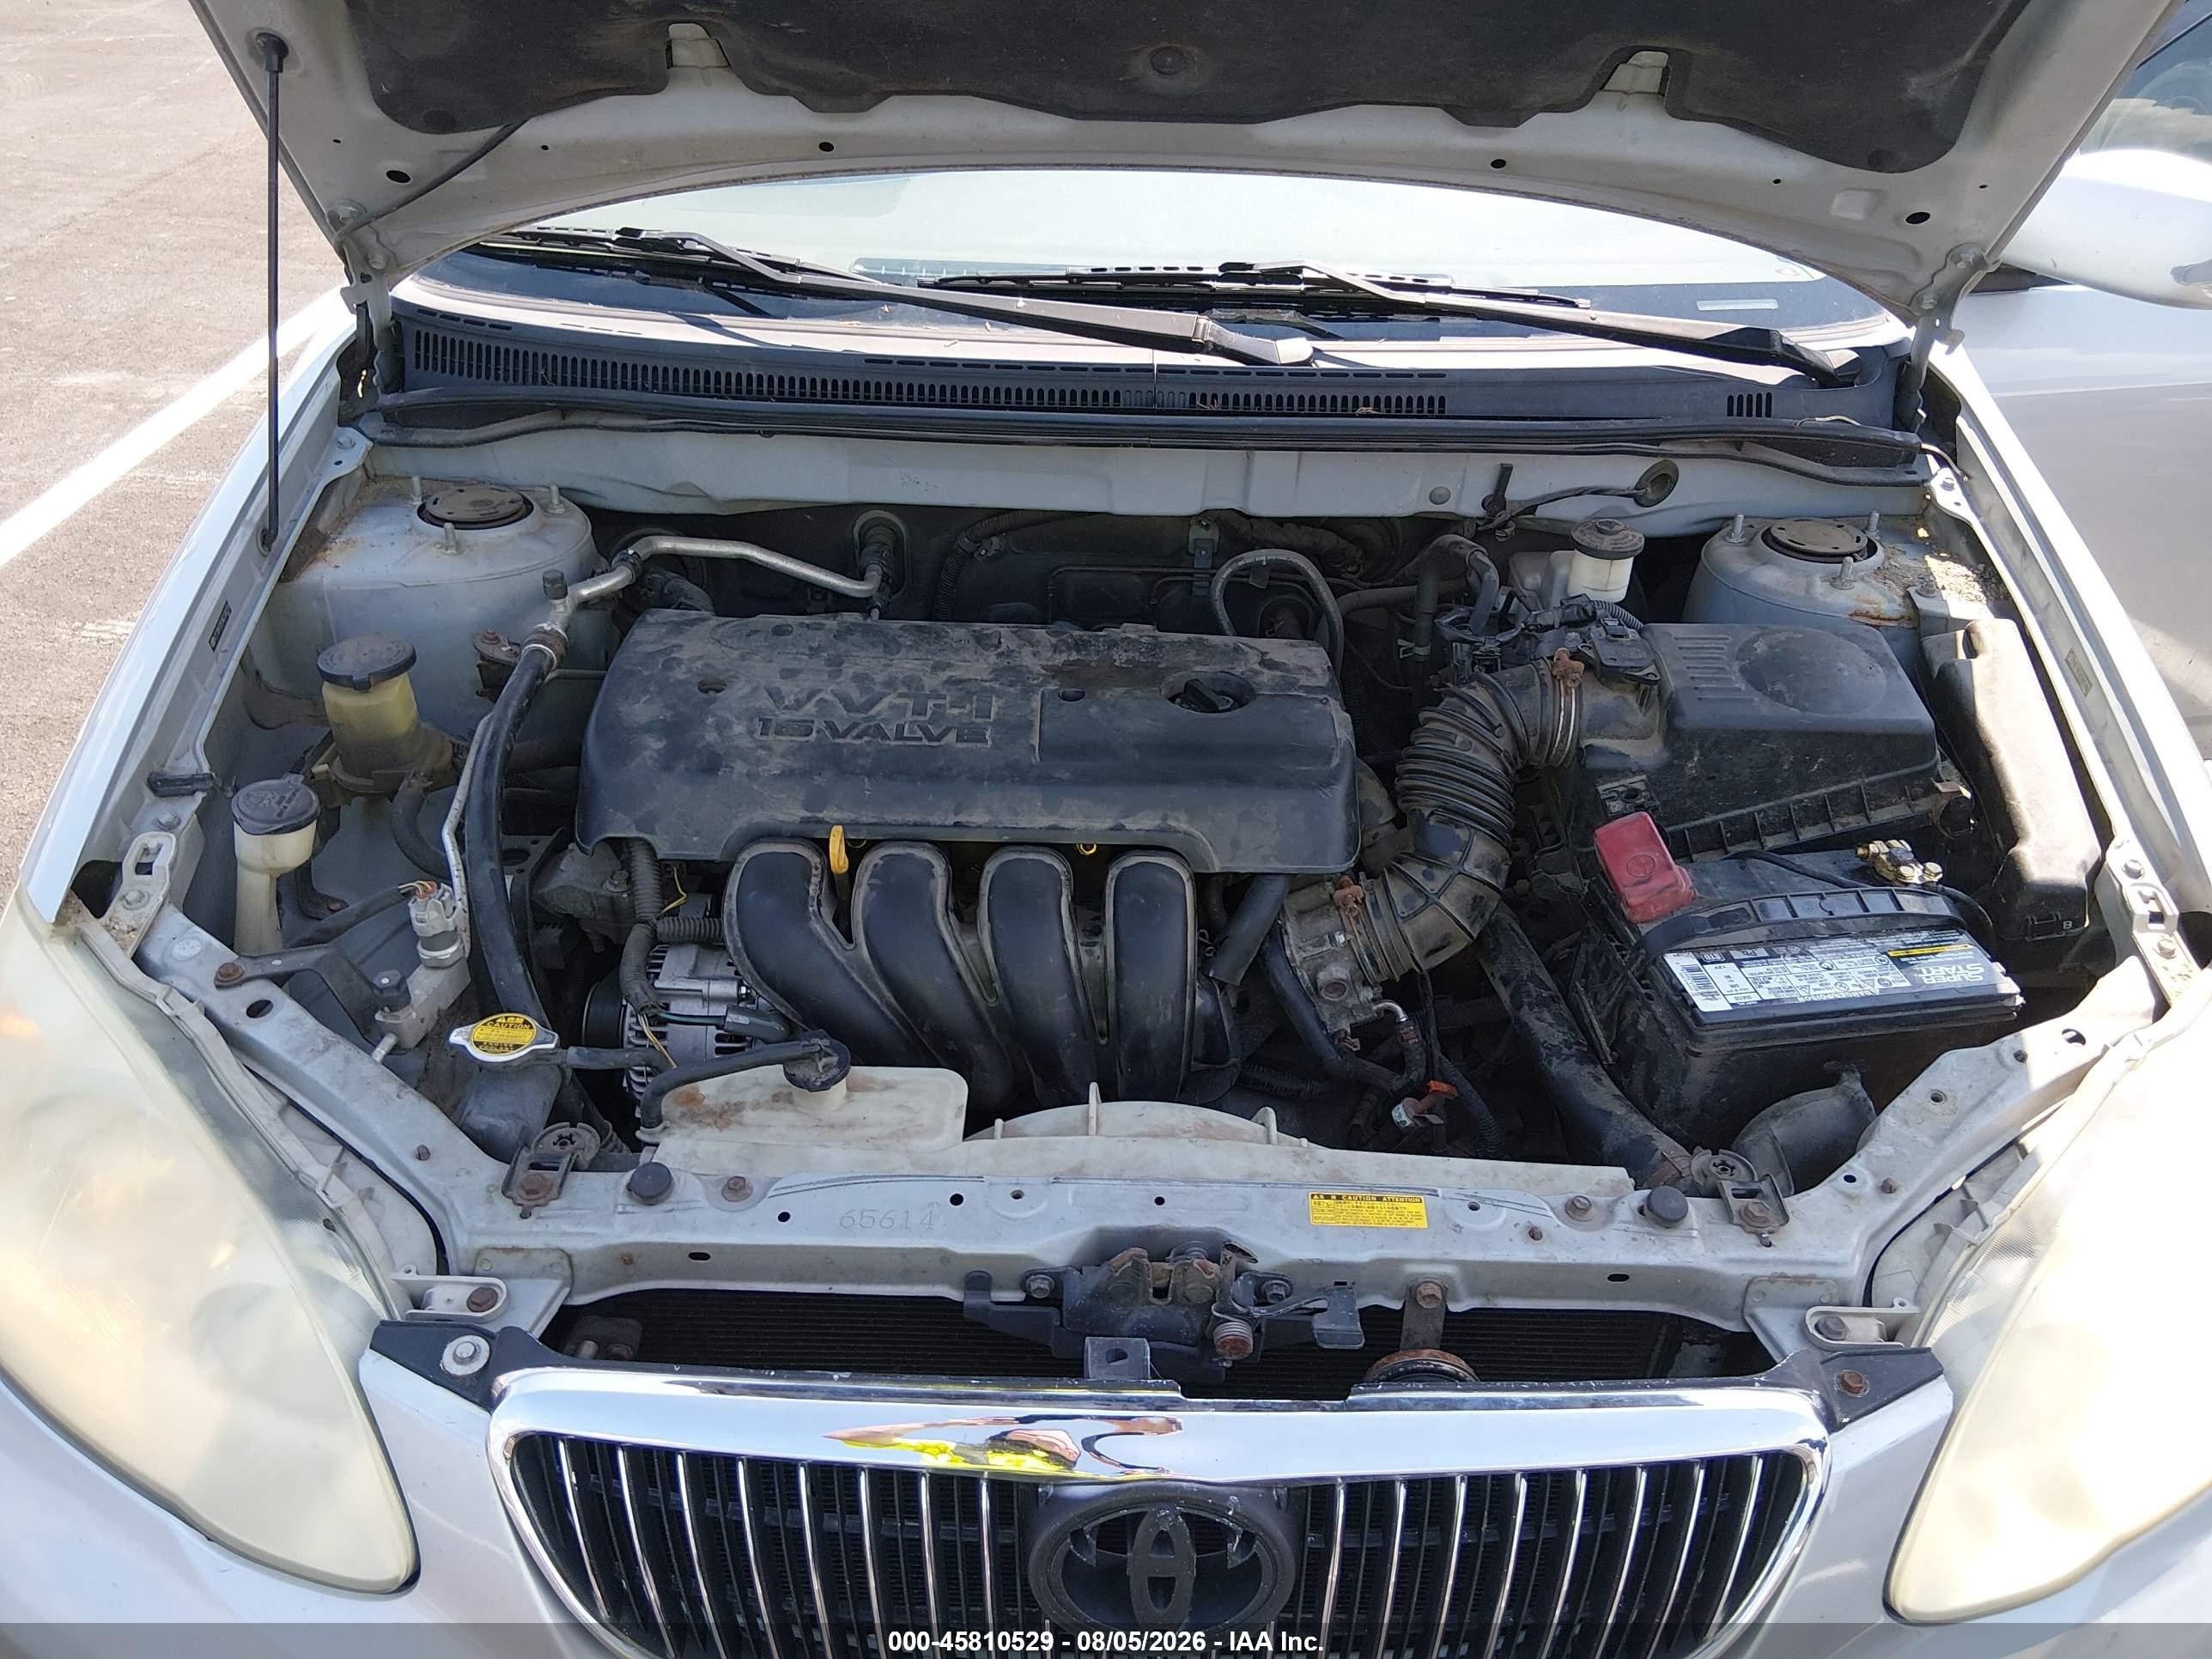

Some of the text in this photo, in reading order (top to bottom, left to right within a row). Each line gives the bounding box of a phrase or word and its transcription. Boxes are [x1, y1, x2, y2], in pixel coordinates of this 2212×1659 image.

[821, 720, 991, 747] VALVE
[1919, 963, 1984, 975] START
[1922, 972, 1984, 985] SUPER
[487, 1021, 531, 1030] CAUTION
[839, 1209, 934, 1230] 65614
